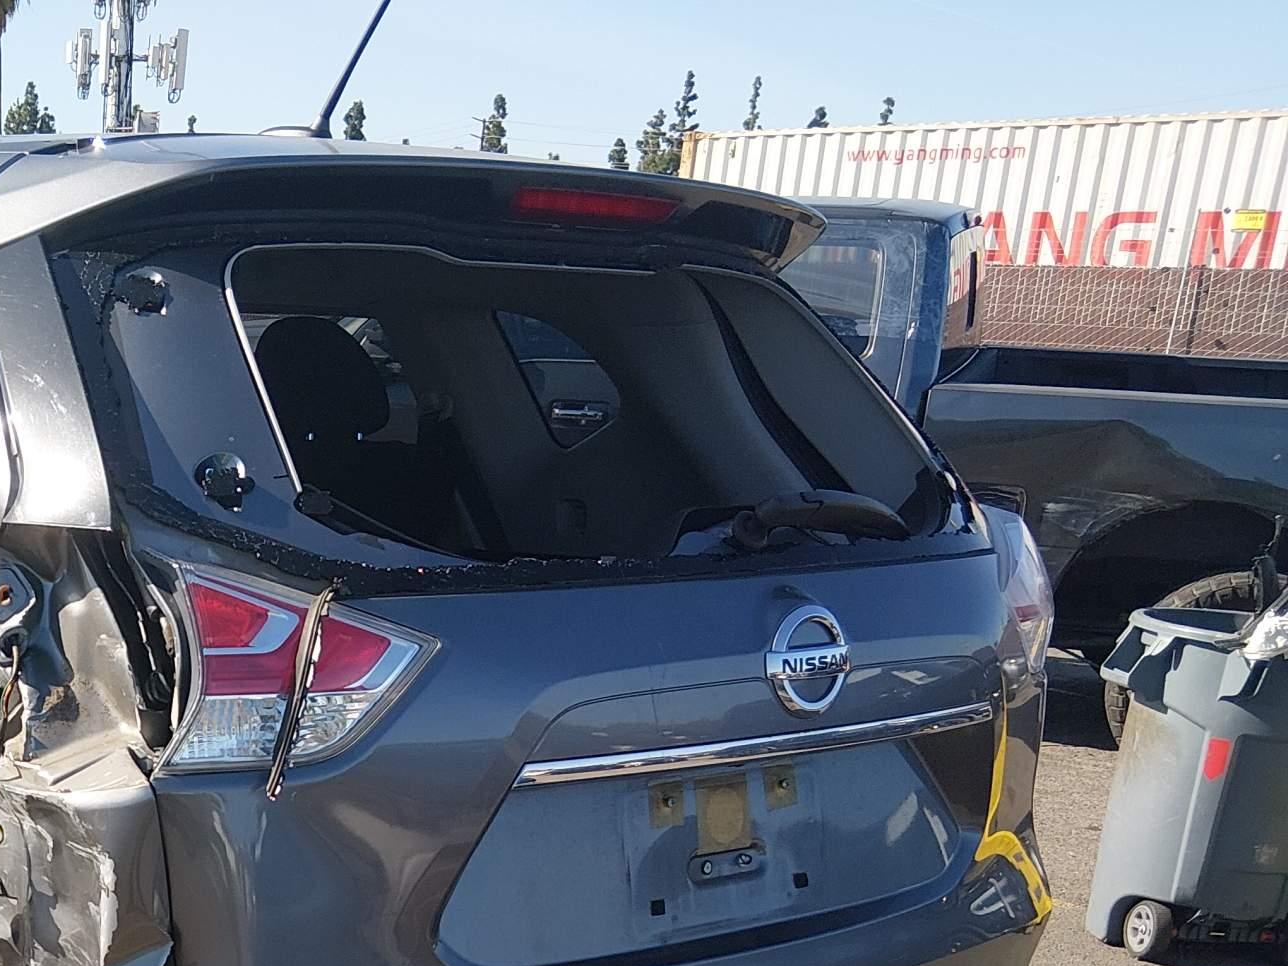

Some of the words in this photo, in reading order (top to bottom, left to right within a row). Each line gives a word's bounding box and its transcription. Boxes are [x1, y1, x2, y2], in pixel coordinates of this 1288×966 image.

[847, 143, 1026, 166] www.yangming.com
[982, 211, 1158, 267] ANG
[1190, 211, 1288, 269] M
[782, 652, 849, 673] NISSAN
